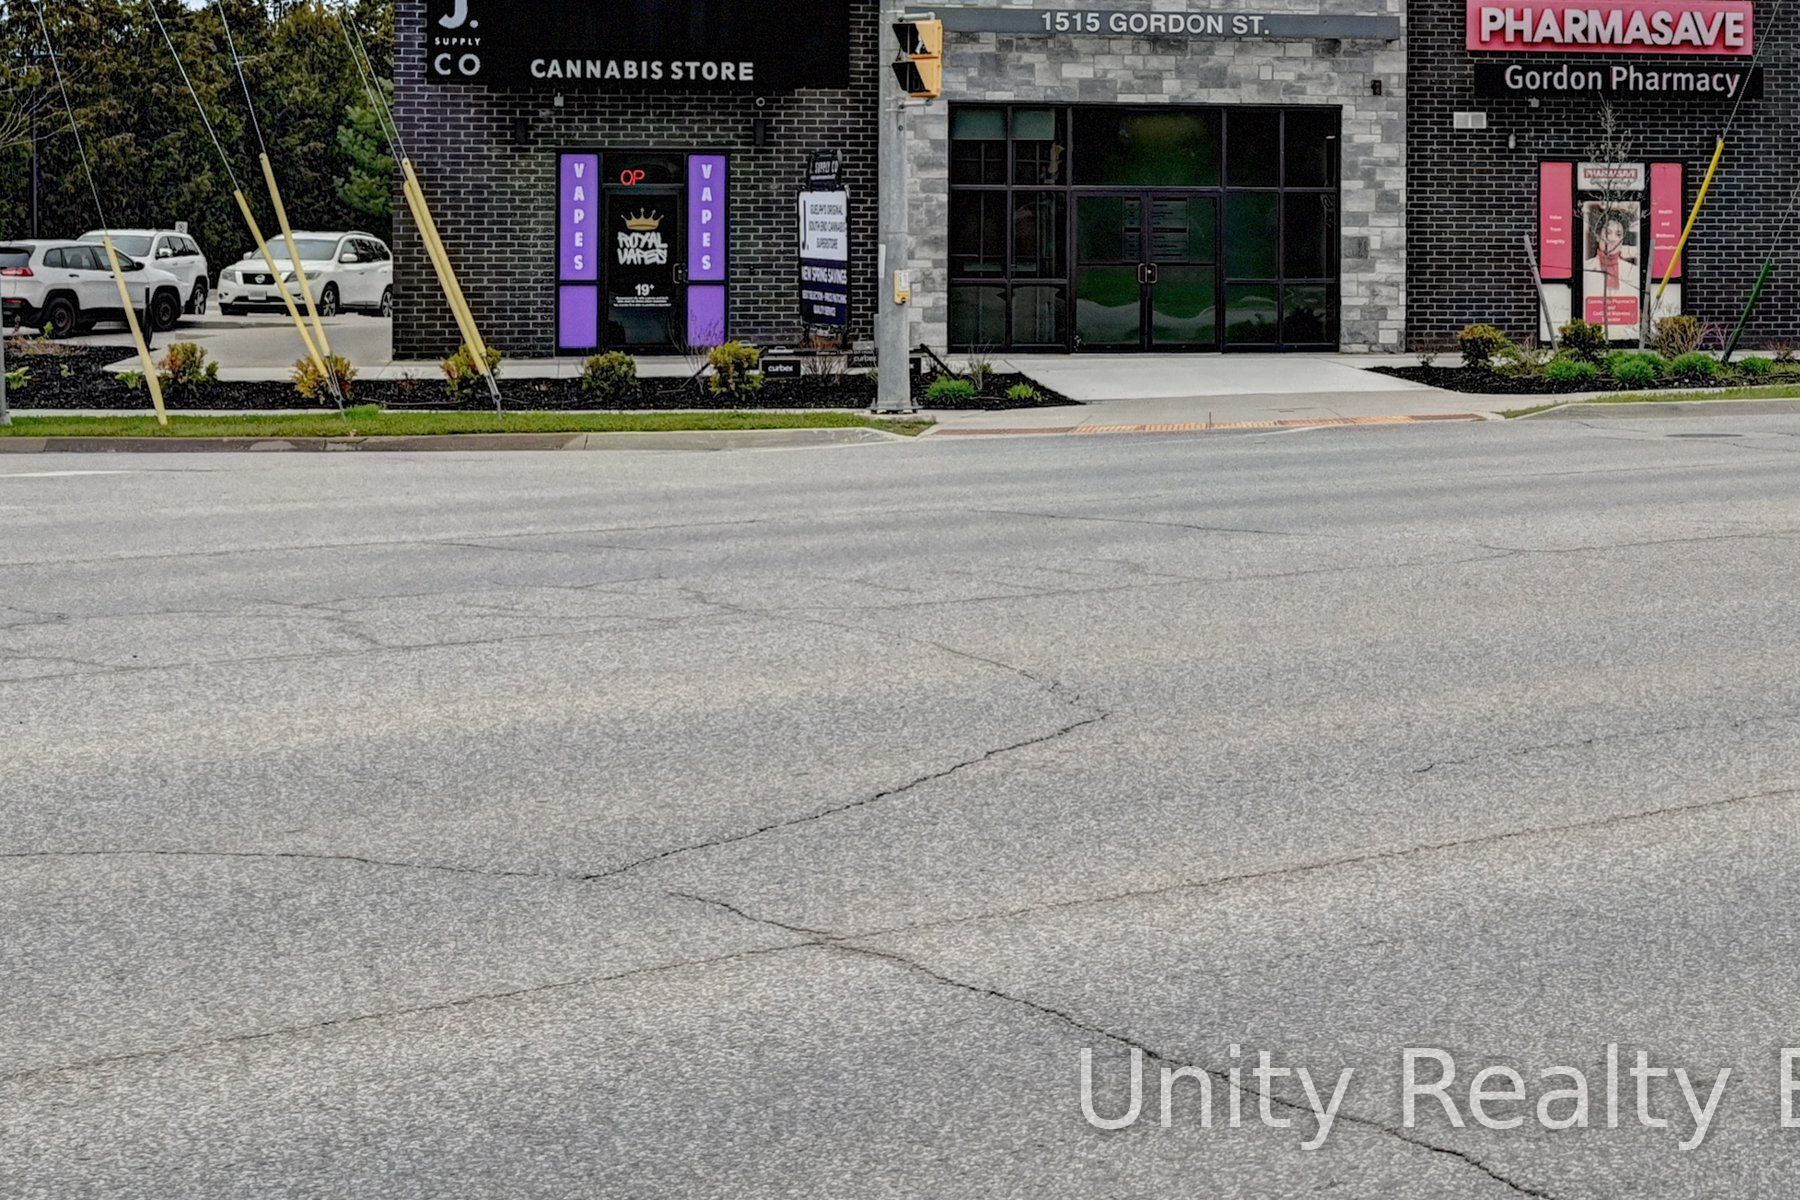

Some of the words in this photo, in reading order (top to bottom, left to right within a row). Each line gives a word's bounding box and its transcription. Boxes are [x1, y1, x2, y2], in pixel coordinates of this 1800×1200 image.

[1042, 12, 1099, 32] 1515
[1109, 14, 1224, 34] GORDON
[1232, 16, 1270, 36] ST.
[1479, 6, 1745, 47] PHARMASAVE
[435, 37, 481, 46] SUPPLY
[434, 53, 481, 76] CO
[530, 59, 663, 80] CANNABIS
[671, 61, 754, 81] STORE
[1504, 64, 1602, 91] Gordon
[1610, 65, 1741, 98] Pharmacy
[620, 169, 646, 186] OP
[574, 163, 585, 270] VAPES
[701, 164, 712, 270] VAPES
[617, 232, 669, 248] ROYAL
[617, 249, 668, 265] VAPES
